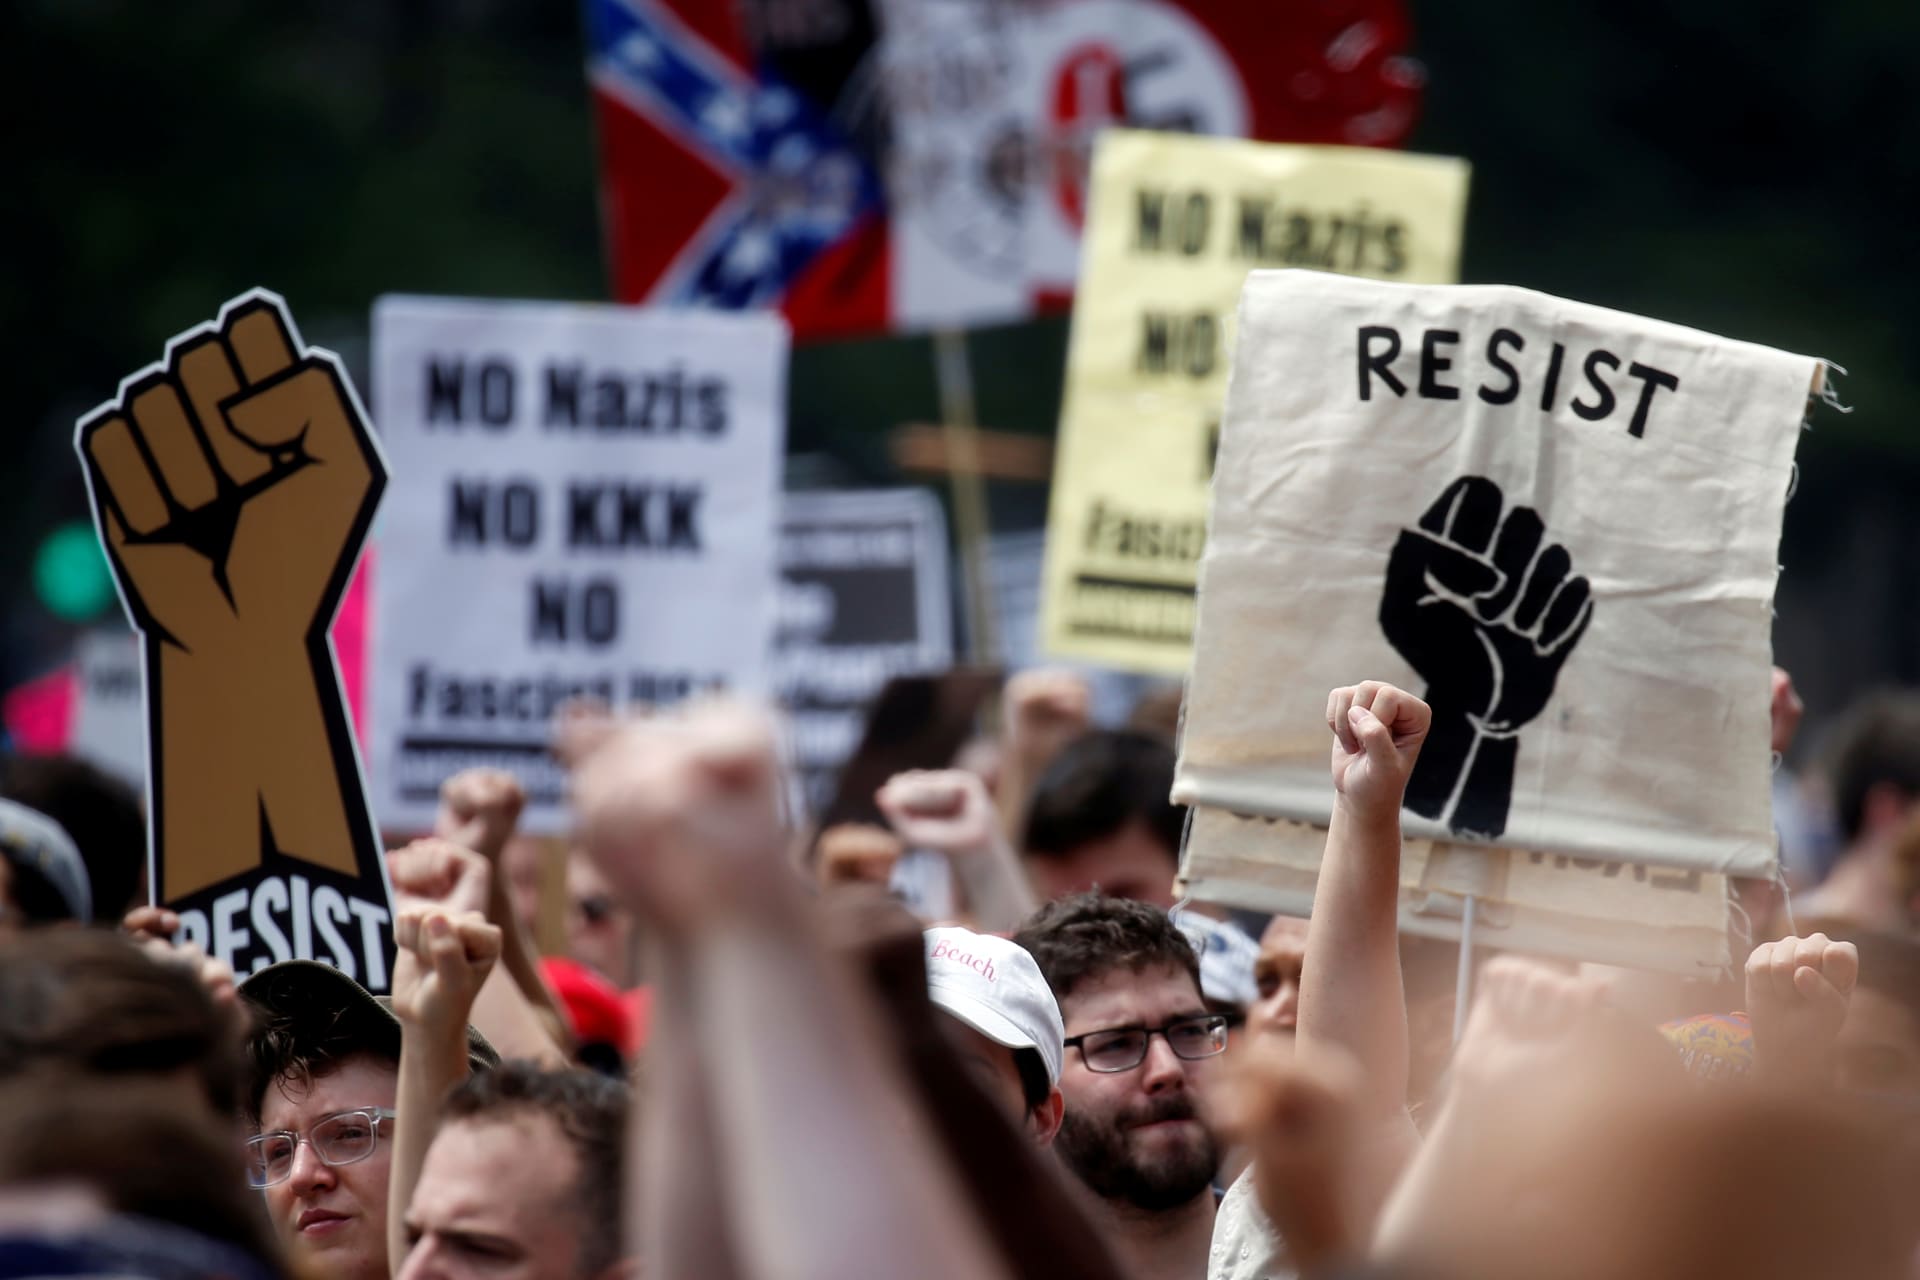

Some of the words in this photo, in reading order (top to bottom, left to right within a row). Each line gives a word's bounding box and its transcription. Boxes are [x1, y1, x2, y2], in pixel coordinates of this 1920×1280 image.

[1133, 187, 1212, 258] NO
[1232, 196, 1411, 272] Nazis
[1136, 312, 1218, 380] NO
[1358, 325, 1680, 440] RESIST
[424, 356, 517, 430] NO
[542, 362, 730, 437] Nazis
[449, 479, 541, 551] NO
[565, 481, 703, 554] KKK
[530, 577, 620, 650] NO
[172, 874, 389, 990] RESIST
[931, 939, 998, 983] Beach
